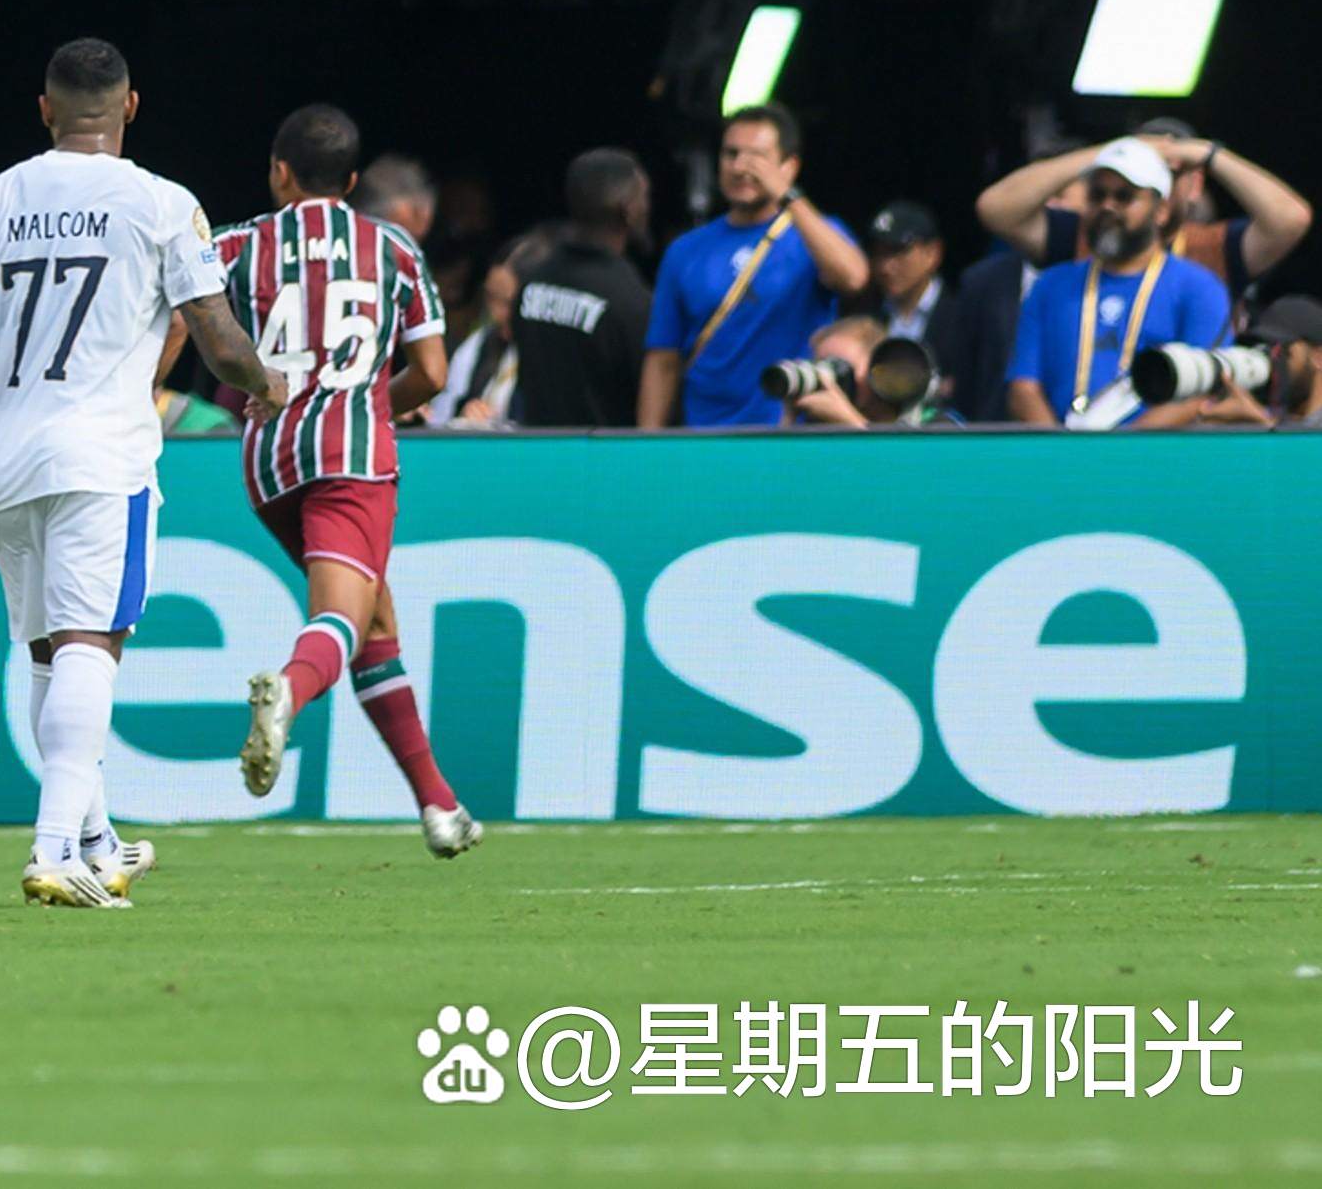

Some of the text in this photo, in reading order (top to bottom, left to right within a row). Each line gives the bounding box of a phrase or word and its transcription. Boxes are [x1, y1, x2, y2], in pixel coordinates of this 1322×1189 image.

[7, 210, 109, 243] MALCOM
[282, 237, 349, 265] LIMA
[1, 255, 109, 389] 77
[256, 278, 379, 407] 45
